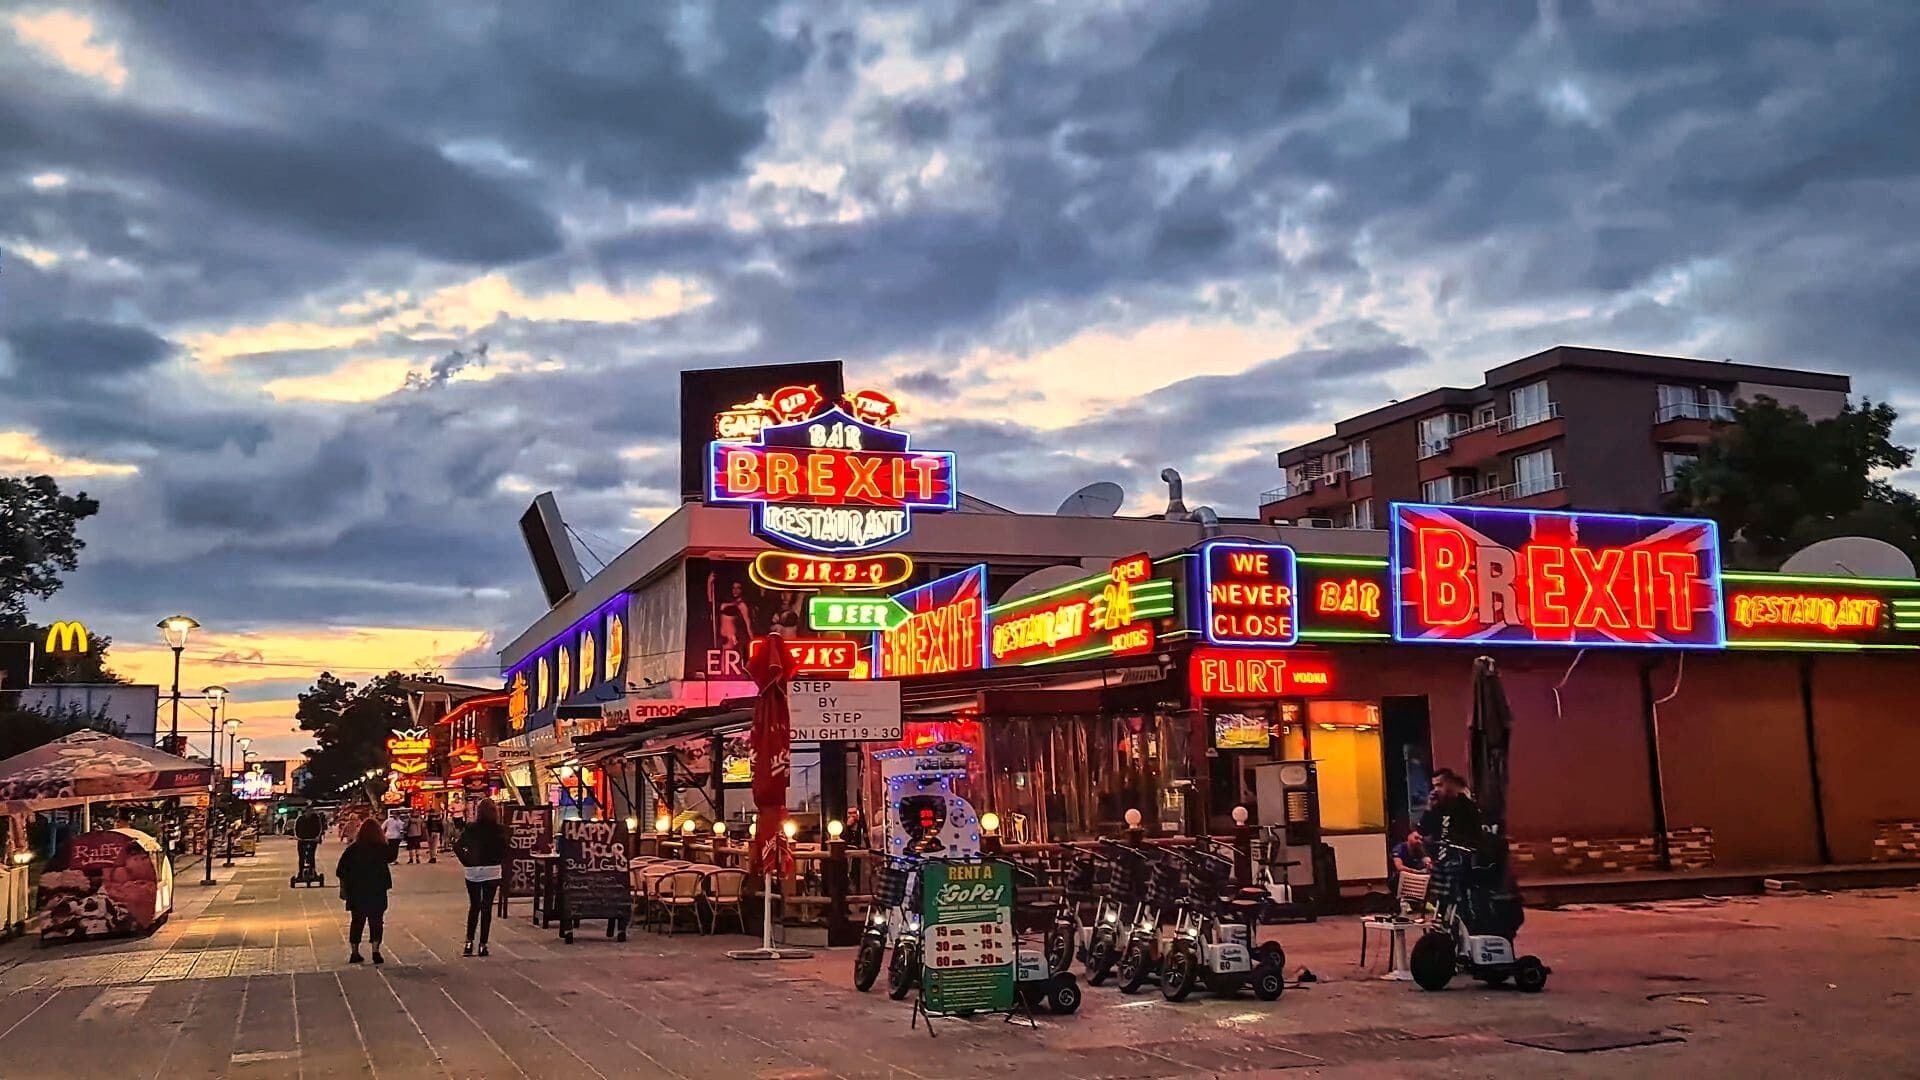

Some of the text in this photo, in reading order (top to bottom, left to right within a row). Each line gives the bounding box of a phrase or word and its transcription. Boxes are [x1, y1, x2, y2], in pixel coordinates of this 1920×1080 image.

[809, 422, 862, 450] BAR
[727, 451, 939, 499] BREXIT
[766, 506, 905, 546] RESTAURANT
[785, 560, 883, 583] BAR-B-Q
[1111, 559, 1145, 583] OPEN
[1232, 553, 1269, 574] WE
[1419, 527, 1698, 631] BREXIT
[1104, 580, 1129, 630] 24
[1212, 584, 1292, 606] NEVER
[1320, 578, 1380, 618] BAR
[827, 604, 888, 629] BEER
[1734, 594, 1880, 630] RESTAURANT
[992, 603, 1086, 658] RESTAURANT
[1214, 615, 1292, 636] CLOSE
[881, 597, 976, 677] BREXIT
[1111, 629, 1149, 651] HOURS
[792, 681, 831, 692] STEP
[1200, 659, 1328, 693] FLIRT VODKA
[818, 697, 838, 708] BY
[822, 712, 862, 723] STEP
[789, 728, 847, 740] ONIGHT
[512, 809, 545, 824] LIVE
[509, 836, 537, 849] STEP
[565, 821, 616, 844] HAPPY
[74, 843, 123, 859] Raffy
[582, 841, 627, 861] HOUR
[512, 859, 536, 873] STE
[948, 865, 993, 880] RENT A
[935, 926, 947, 937] 15
[980, 923, 992, 934] 10
[935, 940, 949, 951] 30
[980, 938, 993, 949] 15
[936, 955, 950, 967] 60
[980, 953, 994, 964] 20
